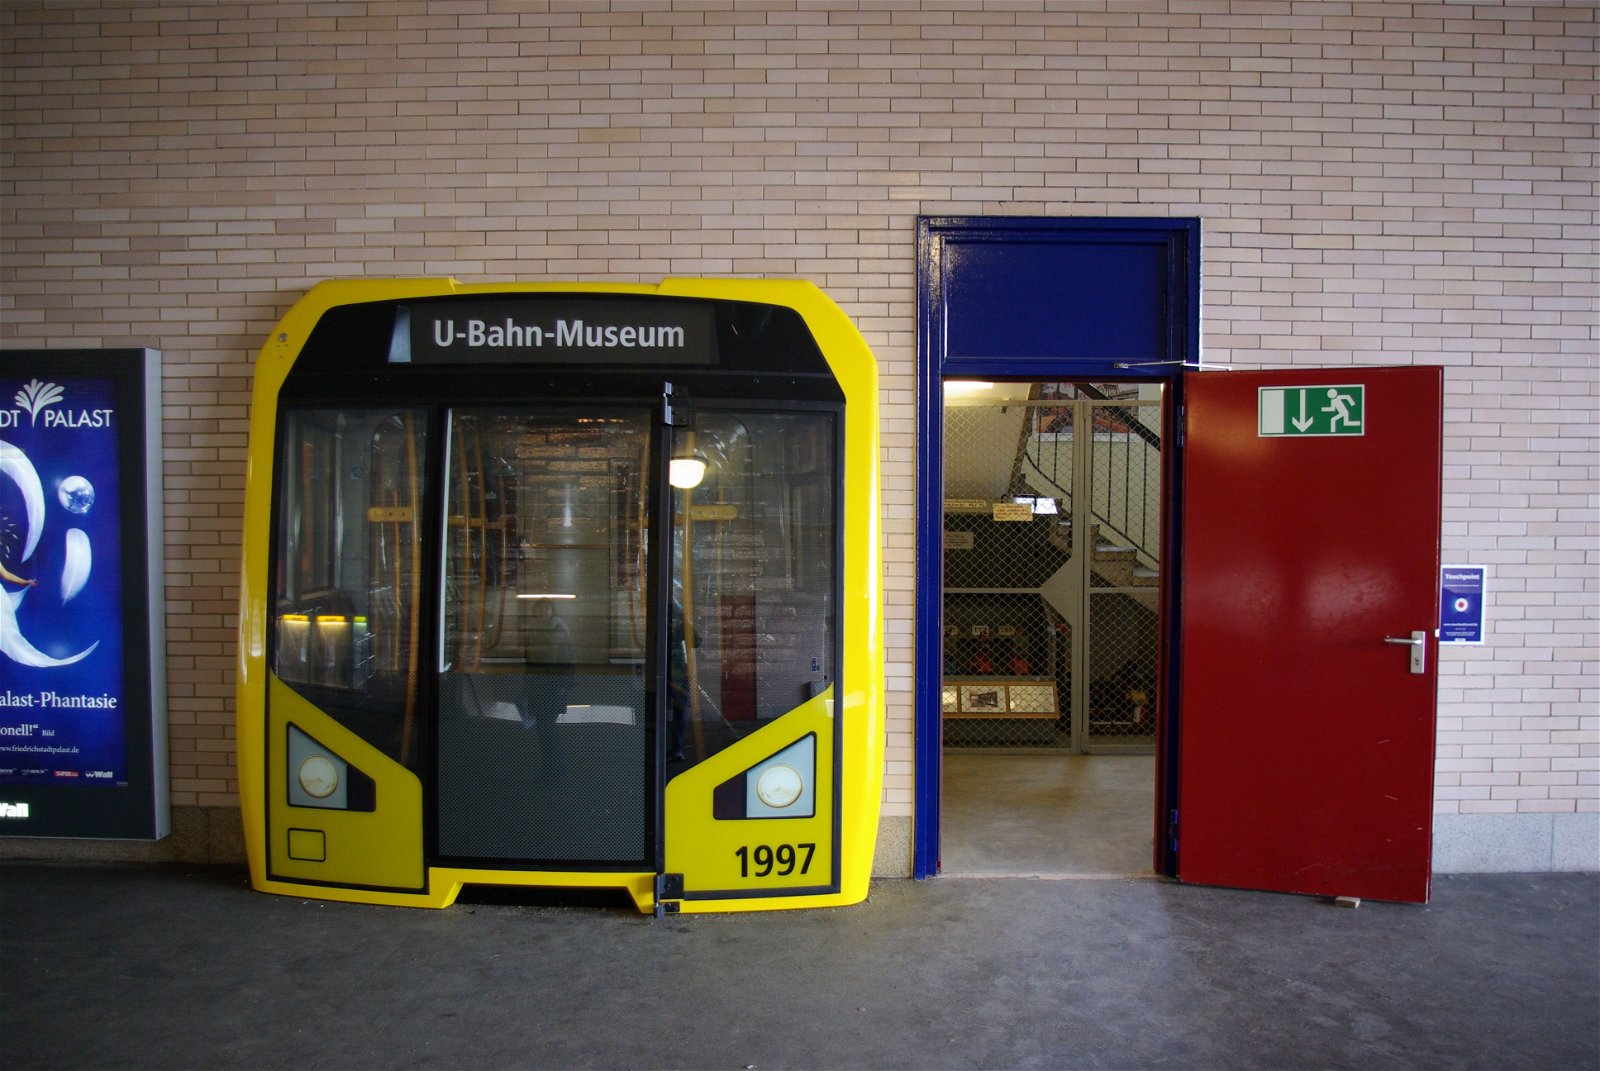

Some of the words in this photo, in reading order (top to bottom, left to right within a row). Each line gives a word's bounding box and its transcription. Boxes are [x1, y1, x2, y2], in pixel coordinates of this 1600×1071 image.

[434, 317, 685, 348] U-Bahn-Museum
[45, 409, 113, 427] PALAST
[42, 729, 55, 737] Bild
[735, 843, 816, 878] 1997
